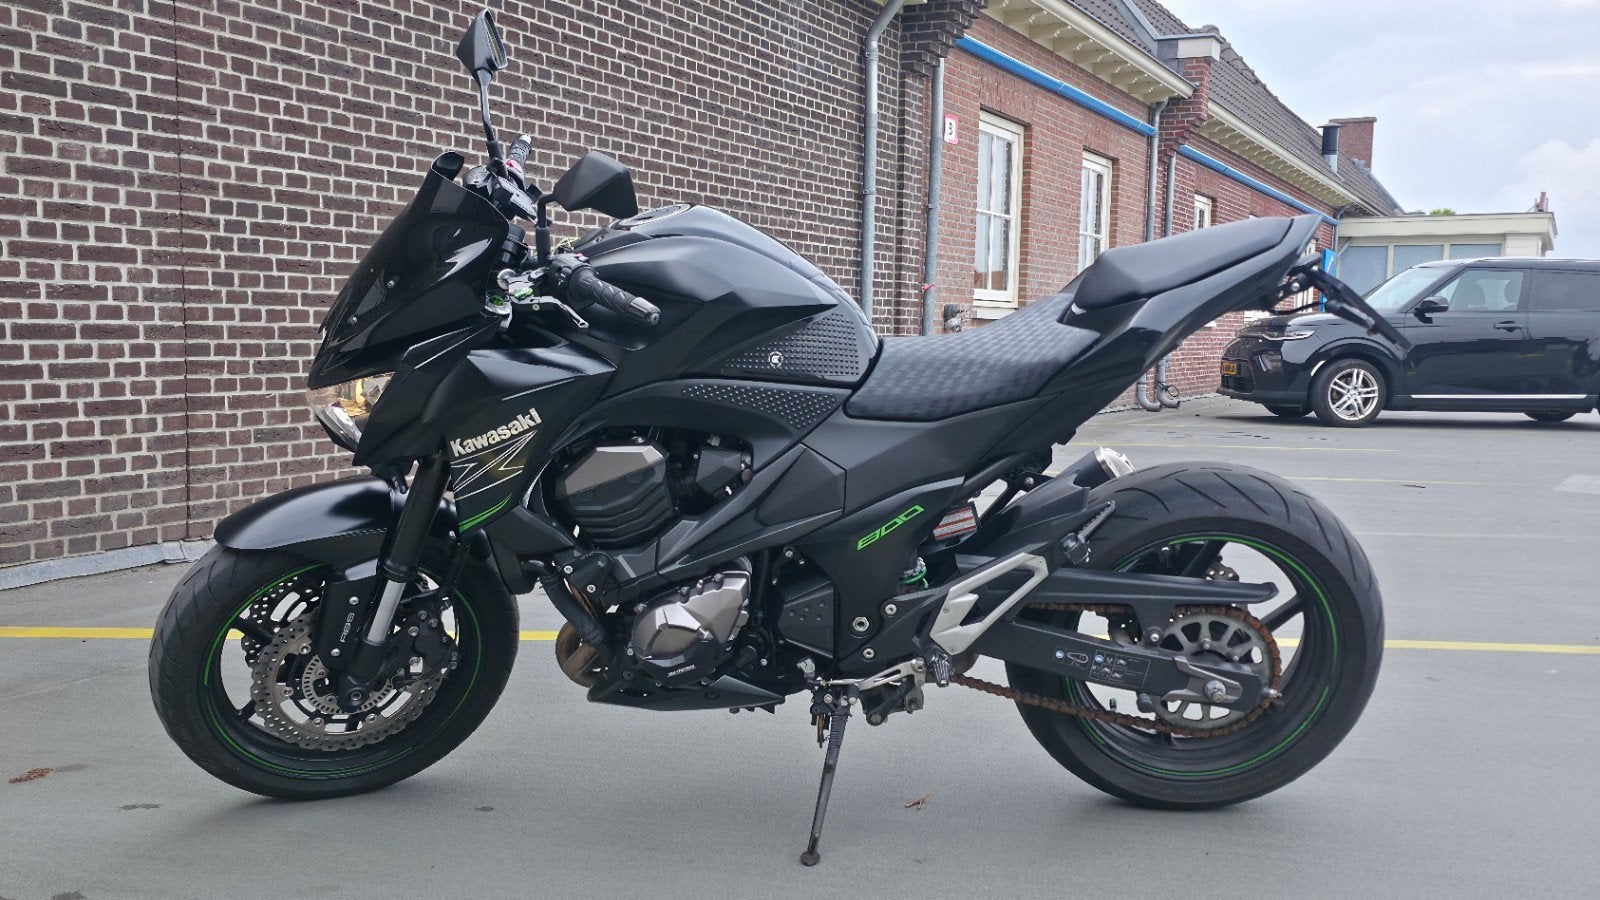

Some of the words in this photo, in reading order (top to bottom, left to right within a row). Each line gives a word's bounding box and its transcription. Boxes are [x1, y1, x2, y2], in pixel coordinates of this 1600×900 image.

[450, 407, 542, 458] Kawasaki
[857, 504, 925, 551] 800
[339, 612, 355, 643] ABS
